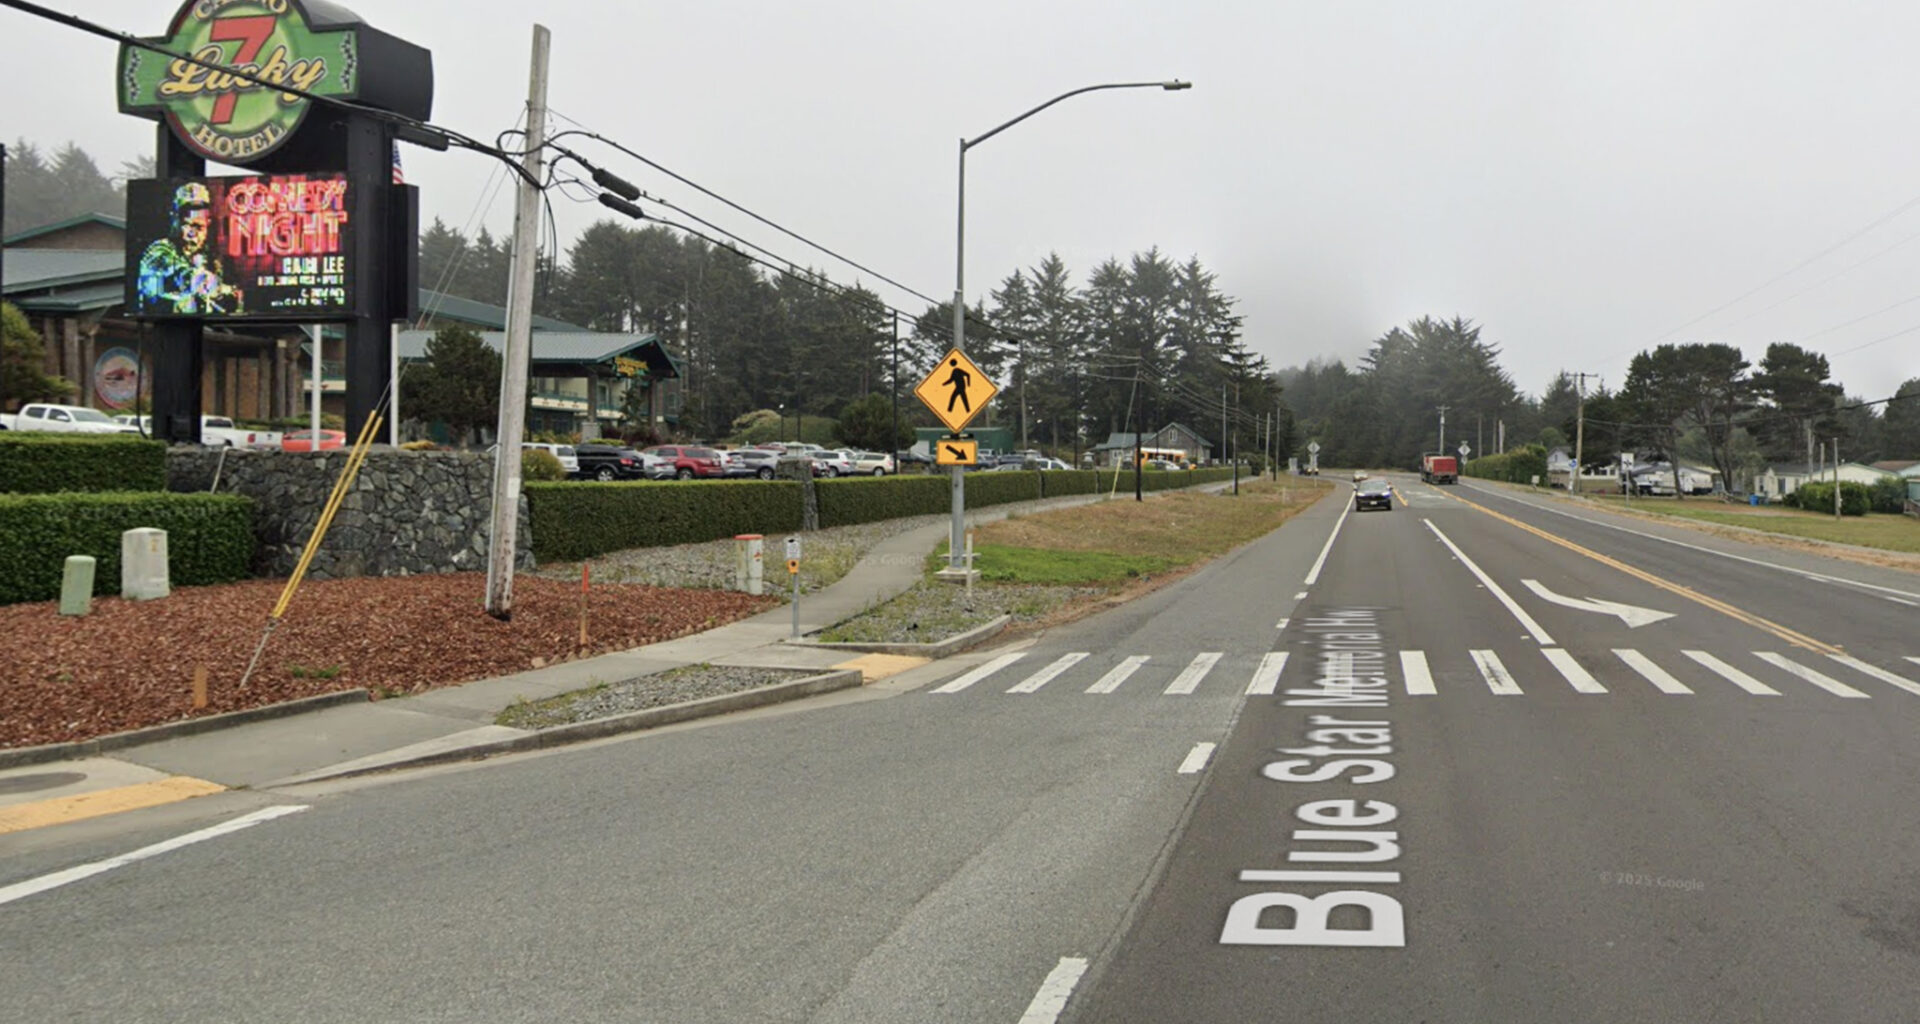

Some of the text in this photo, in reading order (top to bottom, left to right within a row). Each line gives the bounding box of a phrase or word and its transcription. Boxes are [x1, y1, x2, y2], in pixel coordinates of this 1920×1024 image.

[159, 44, 325, 103] Lucky
[211, 14, 278, 124] 7
[192, 123, 287, 157] HOTEL
[227, 179, 347, 213] COMEDY
[228, 211, 347, 256] NIGHT
[323, 255, 345, 274] LEE
